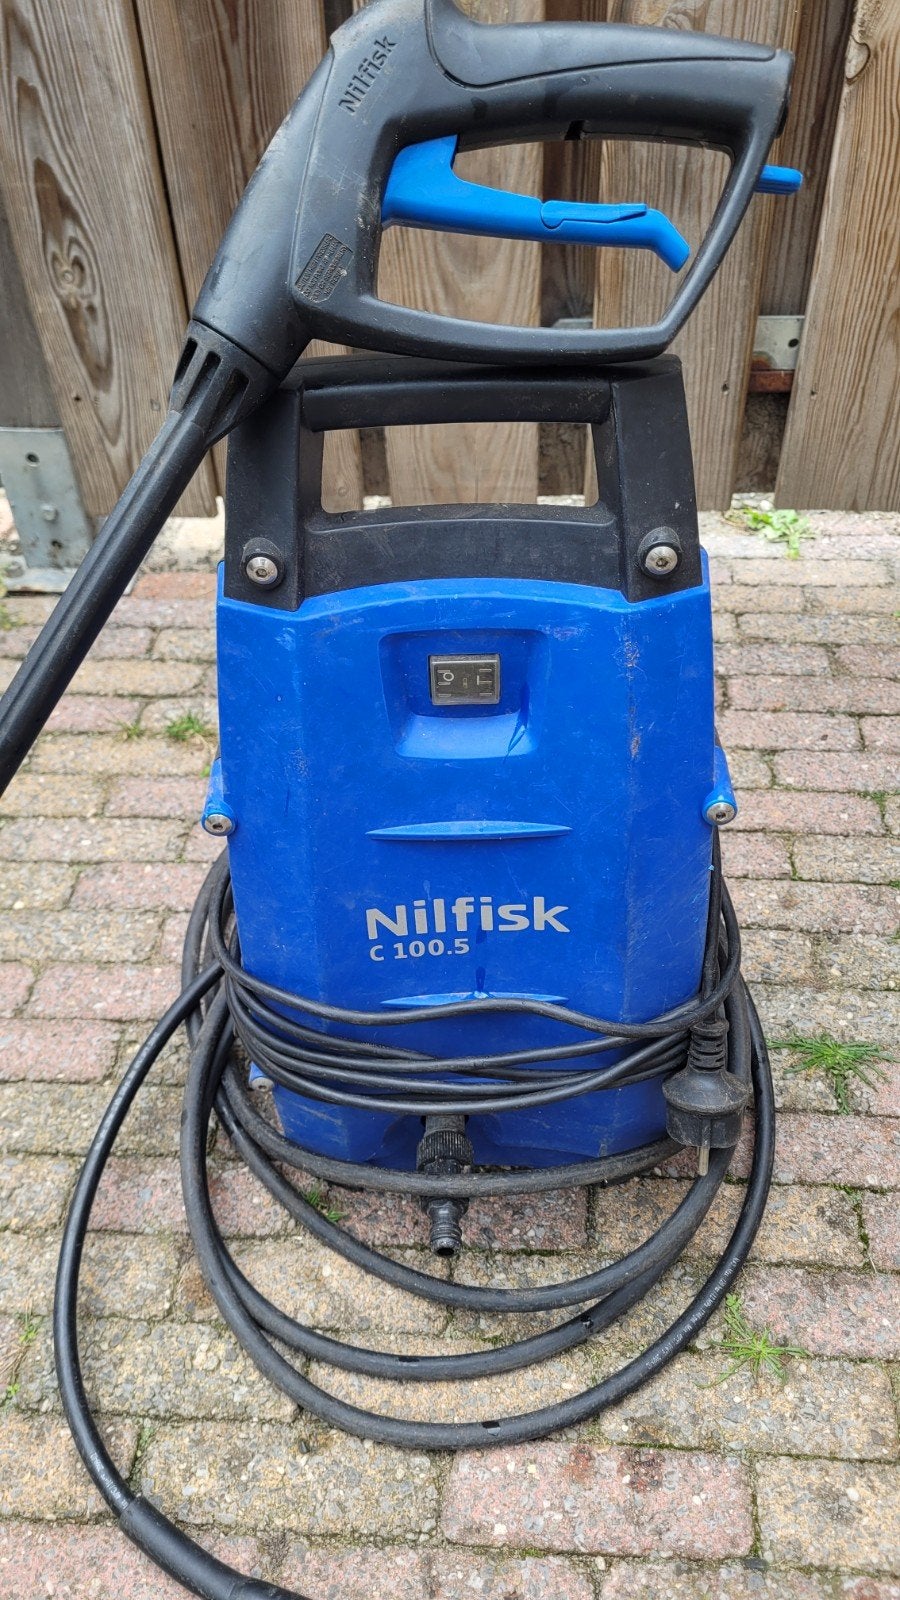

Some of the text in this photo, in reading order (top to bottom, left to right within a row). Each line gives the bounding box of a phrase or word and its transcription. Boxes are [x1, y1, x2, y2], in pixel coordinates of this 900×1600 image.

[338, 35, 398, 113] Nilfisk
[365, 896, 570, 940] Nilfisk
[393, 938, 470, 960] 100.5
